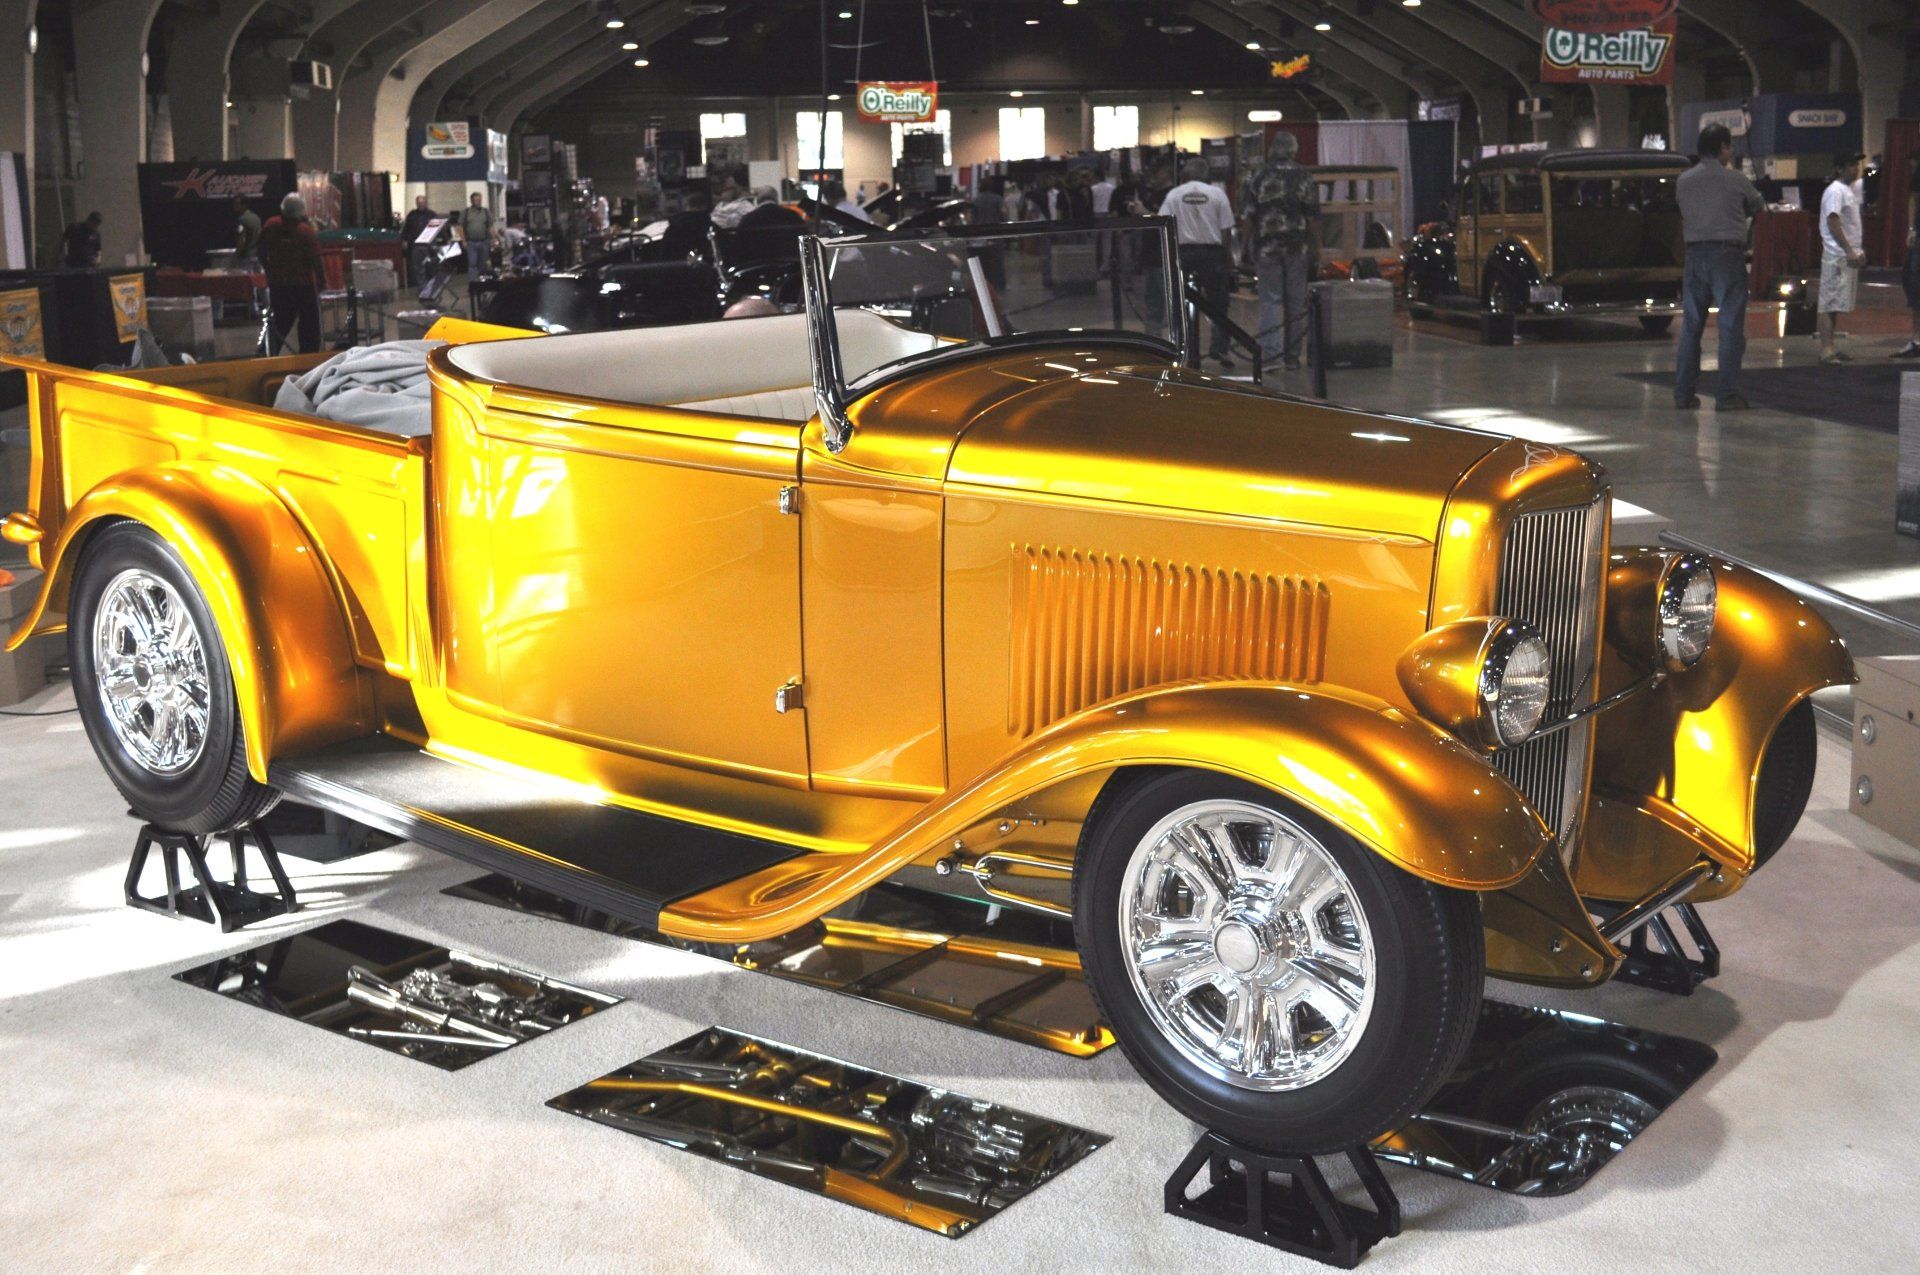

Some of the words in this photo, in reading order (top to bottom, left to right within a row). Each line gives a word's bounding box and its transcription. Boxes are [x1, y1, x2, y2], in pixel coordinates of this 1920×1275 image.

[1546, 28, 1666, 70] OReilly
[1578, 69, 1604, 79] AUTO
[1604, 70, 1635, 80] PARTS
[863, 88, 930, 114] O'Reilly
[1797, 113, 1821, 123] SNACK
